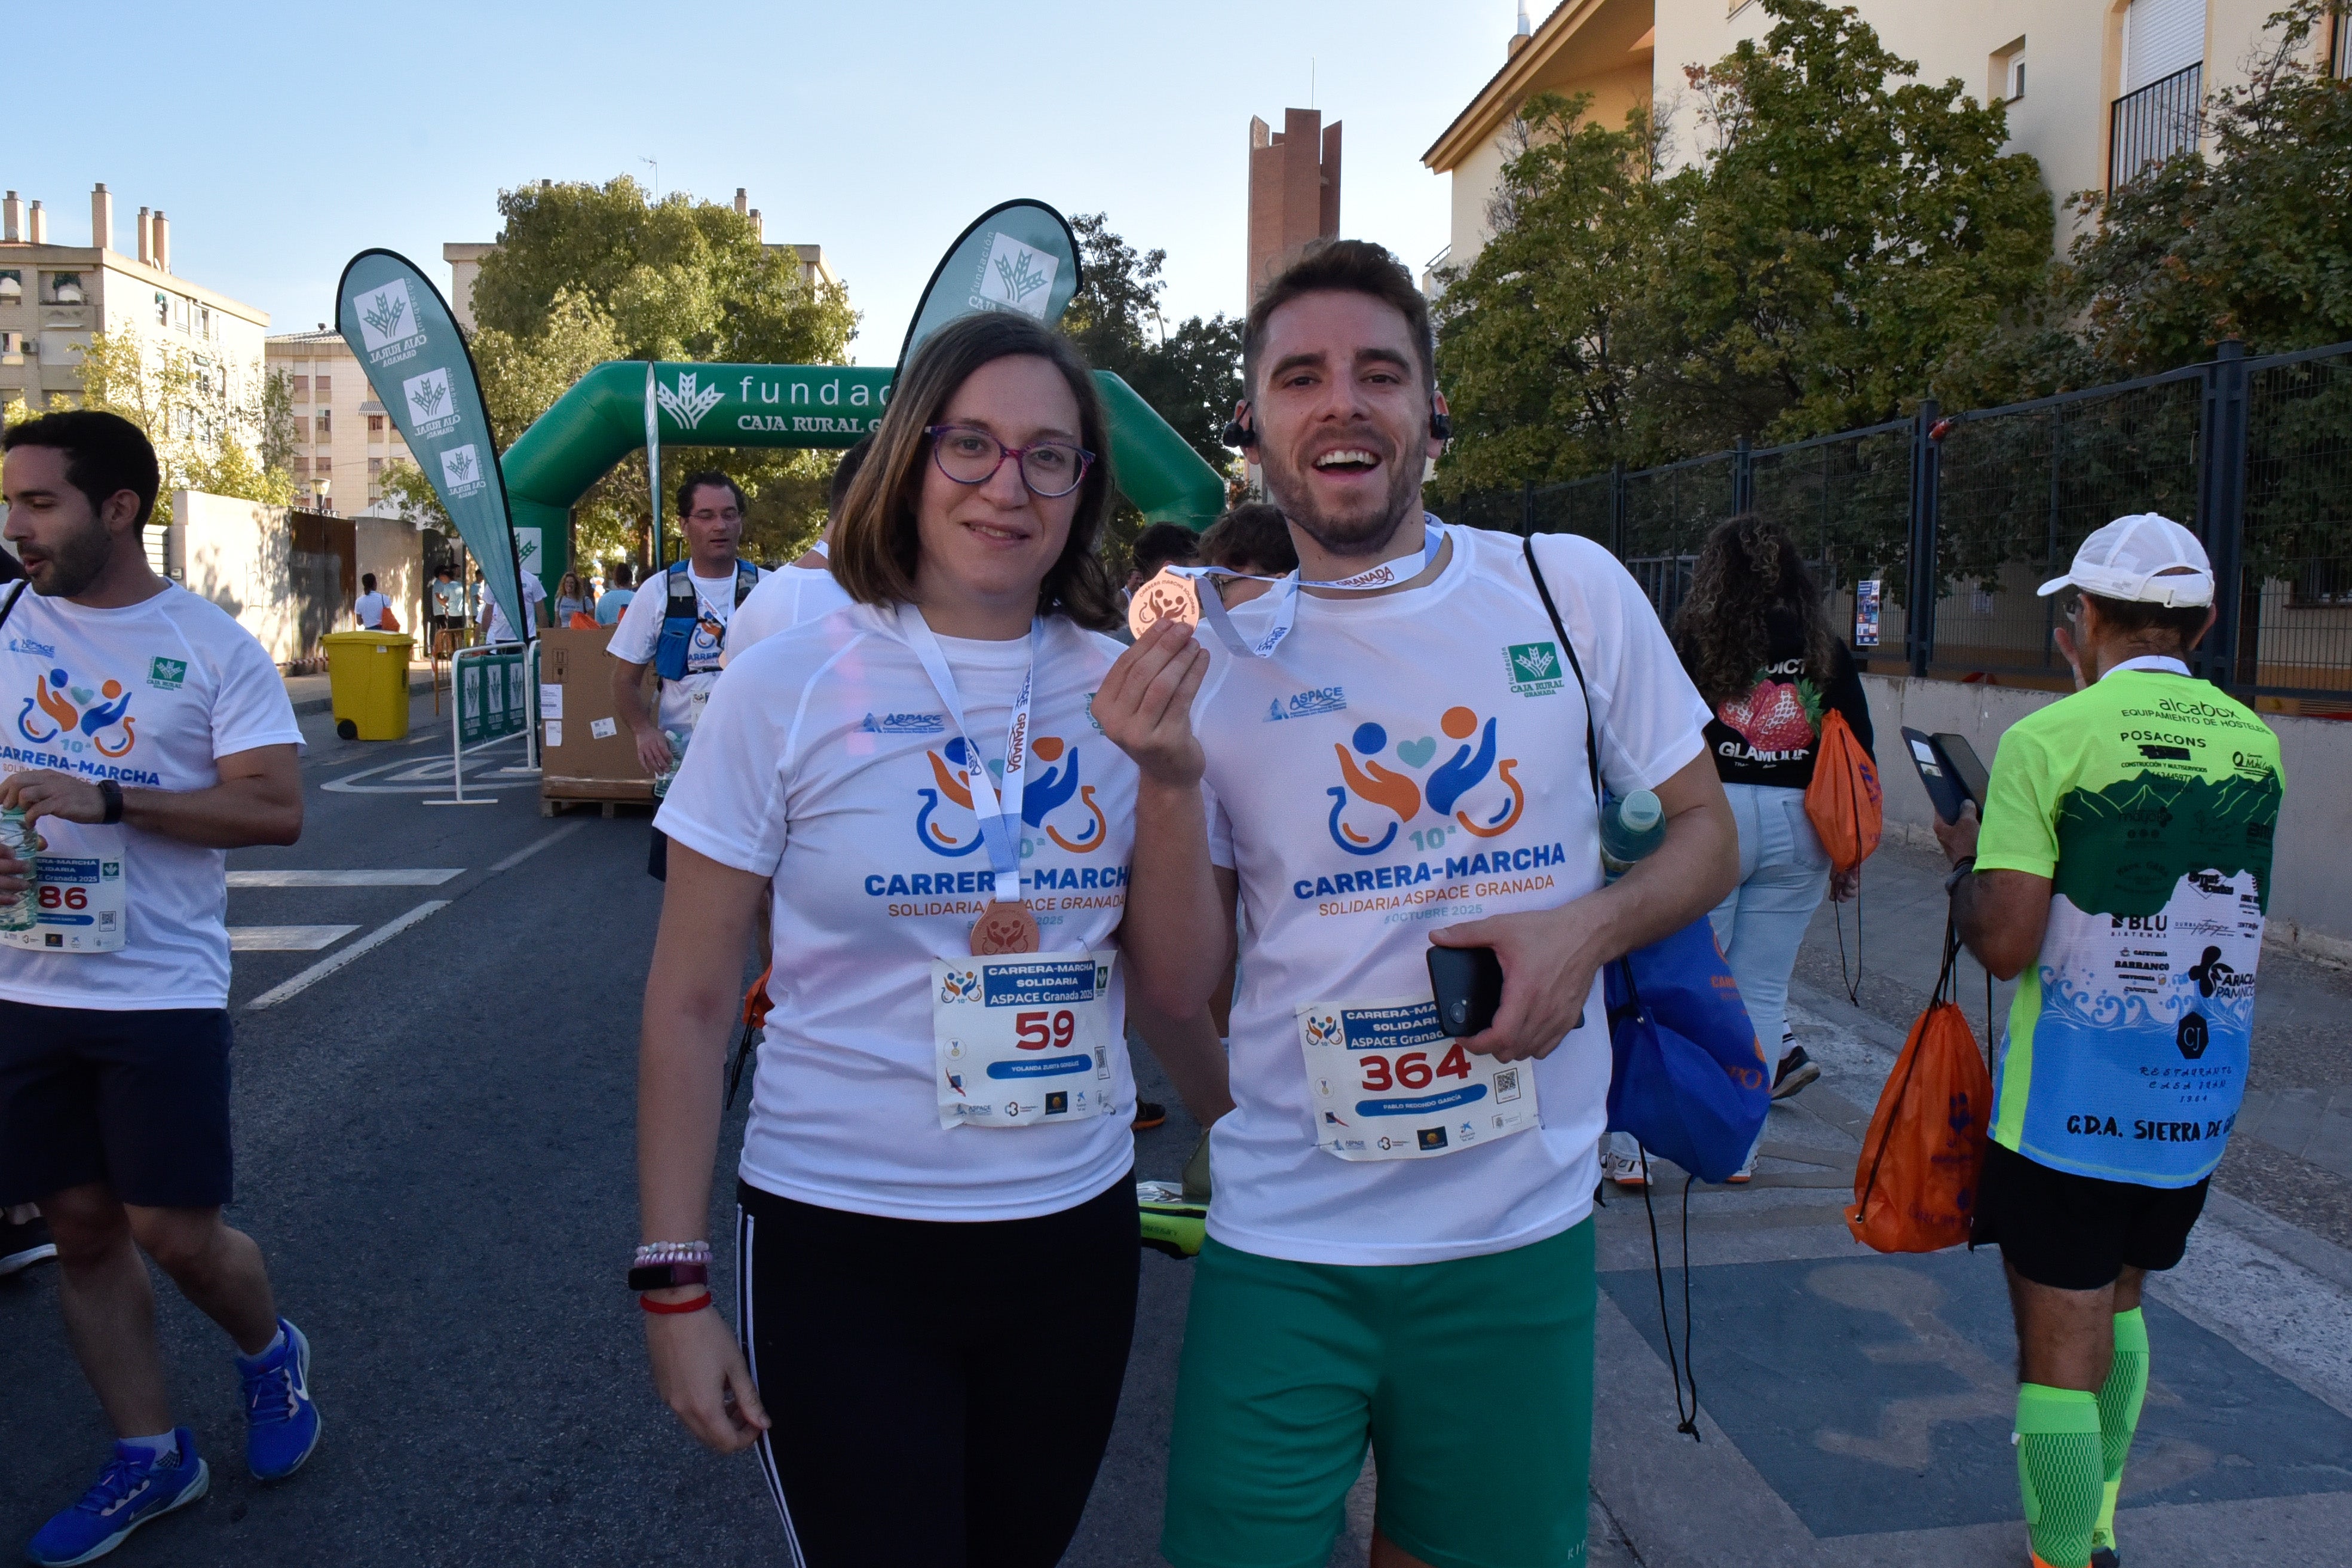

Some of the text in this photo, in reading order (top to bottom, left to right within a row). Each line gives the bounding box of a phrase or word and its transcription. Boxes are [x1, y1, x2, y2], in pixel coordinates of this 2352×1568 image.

[739, 376, 890, 406] fundac
[737, 415, 788, 431] CAJA
[792, 416, 864, 433] RURAL
[1336, 566, 1394, 587] GRANADA
[1511, 680, 1564, 693] CAJA RURAL
[1524, 690, 1556, 698] GRANADA
[1290, 687, 1343, 710] ASPACE
[2159, 698, 2240, 719] alcabox
[883, 713, 943, 726] ASPACE
[2121, 709, 2200, 724] EQUIPAMIENTO
[2221, 719, 2271, 735] HOSTELER
[1006, 713, 1027, 773] GRANADA
[2120, 731, 2206, 748] POSACONS
[2167, 764, 2207, 773] MULTISERVICIOS
[1019, 838, 1045, 859] 0ª
[1293, 843, 1566, 899] CARRERA-MARCHA
[865, 867, 1129, 896] CARRER-MARCH
[38, 886, 88, 910] 86
[1319, 875, 1555, 916] SOLIDARIA ASPACE GRANADA
[888, 895, 1126, 916] SOLIDARIA ACE GRANADA
[1392, 906, 1448, 924] OCTUBRE
[1451, 904, 1483, 917] 2025
[2129, 914, 2167, 931] BLU
[988, 963, 1094, 976] CARRERA-MARCHA
[2114, 960, 2170, 970] BARRANCO
[1016, 977, 1078, 988] SOLIDARIA
[990, 989, 1093, 1004] ASPACE Granada 2025
[1346, 1004, 1437, 1019] CARRERA-MA
[1015, 1009, 1074, 1051] 59
[1373, 1016, 1439, 1031] SOLIDARI
[1351, 1031, 1444, 1048] ASPACE Granad
[2183, 1027, 2201, 1051] CJ
[1359, 1043, 1471, 1091] 364
[2139, 1066, 2232, 1076] RESTAURANTE
[2149, 1081, 2191, 1089] CASA
[1438, 1094, 1462, 1104] GARCÍA
[2133, 1120, 2201, 1142] SIERRA
[2205, 1119, 2222, 1140] DE
